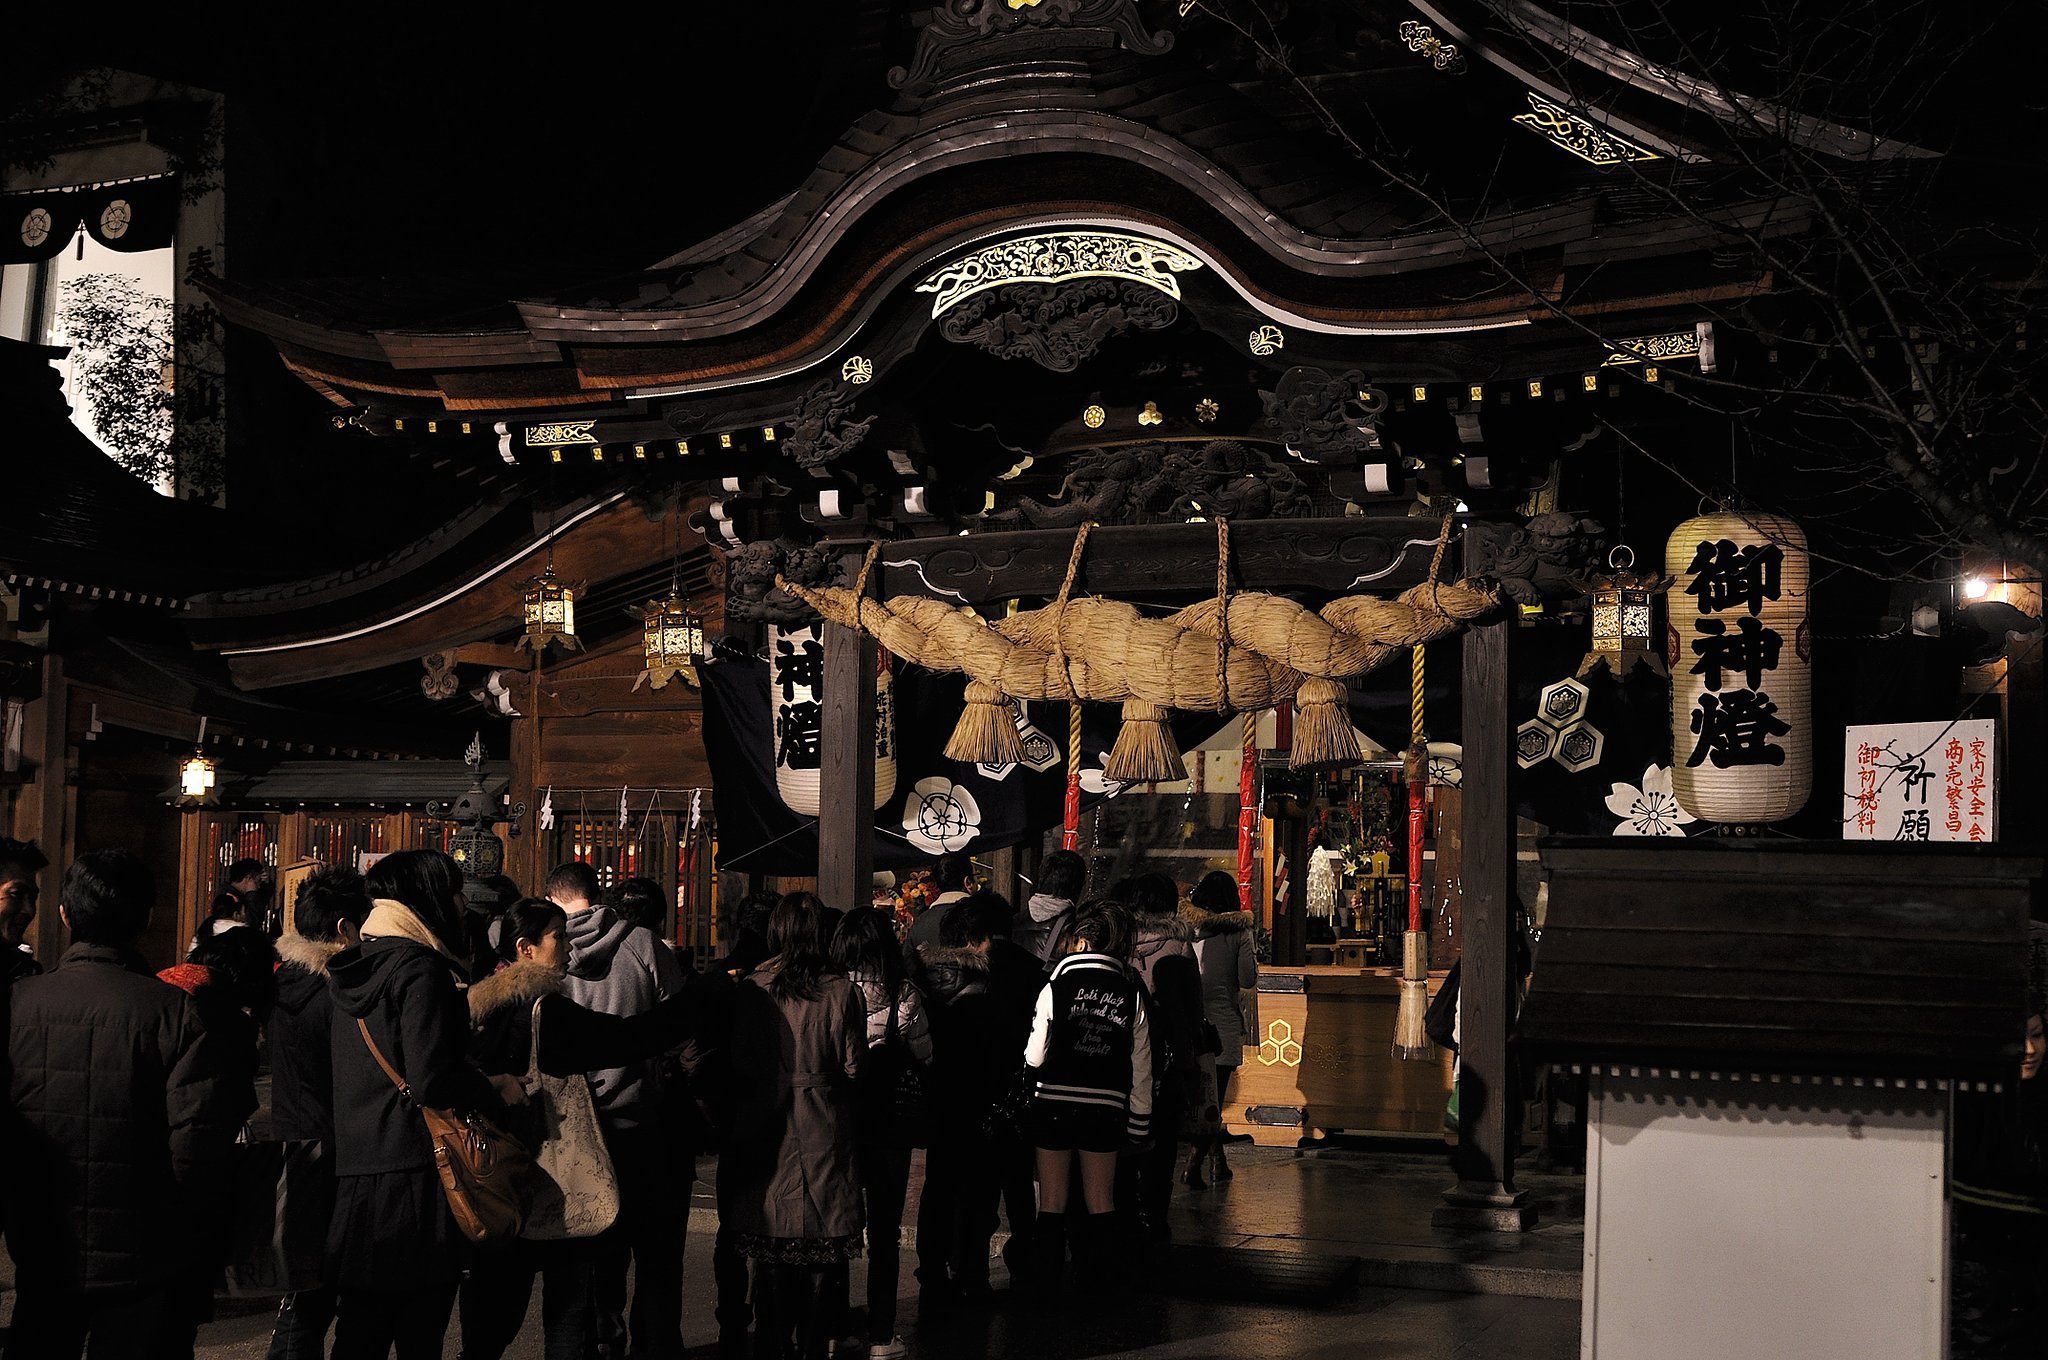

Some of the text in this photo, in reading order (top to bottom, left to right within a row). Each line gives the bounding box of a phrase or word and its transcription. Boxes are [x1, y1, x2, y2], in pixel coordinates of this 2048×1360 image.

[775, 624, 824, 770] 神燈
[1685, 538, 1792, 769] 御神燈
[1857, 742, 1880, 835] 御初穂料
[1895, 753, 1936, 841] 祈願
[1067, 1002, 1128, 1028] Hide and Seek
